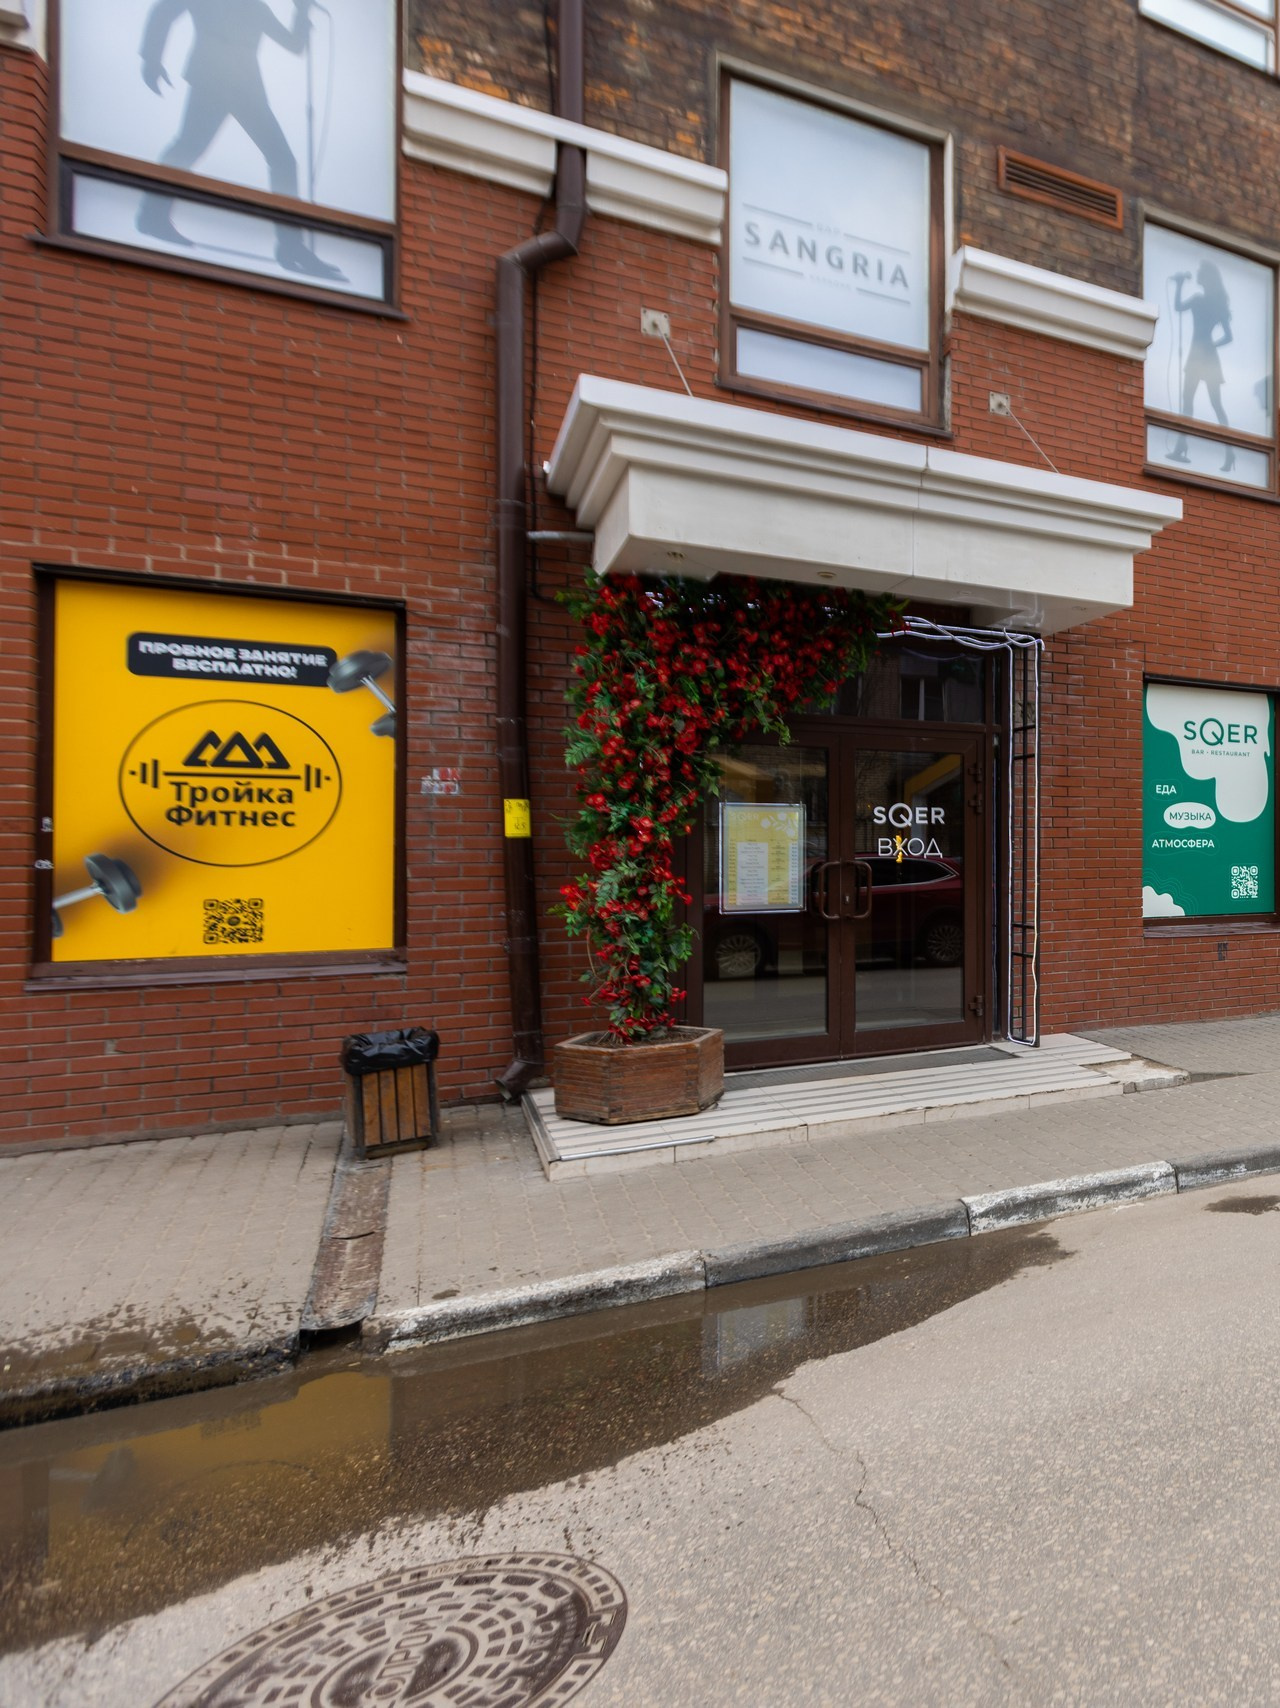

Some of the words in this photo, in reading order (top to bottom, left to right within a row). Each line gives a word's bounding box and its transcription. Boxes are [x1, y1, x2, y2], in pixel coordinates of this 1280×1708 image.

[743, 221, 909, 288] SANGRIA
[138, 640, 236, 659] ПРОБНОЕ
[238, 648, 328, 667] ЗАНЯТИЕ
[172, 657, 298, 679] БЕСПЛАТНО!
[1183, 717, 1258, 746] SQER
[169, 780, 294, 808] Тройка
[1155, 784, 1177, 795] ЕДА
[165, 804, 296, 827] Фитнес
[873, 802, 945, 828] SQER
[1169, 811, 1212, 821] МУЗЫКА
[878, 837, 943, 858] ВХОД
[1152, 838, 1215, 849] АТМОСФЕРА
